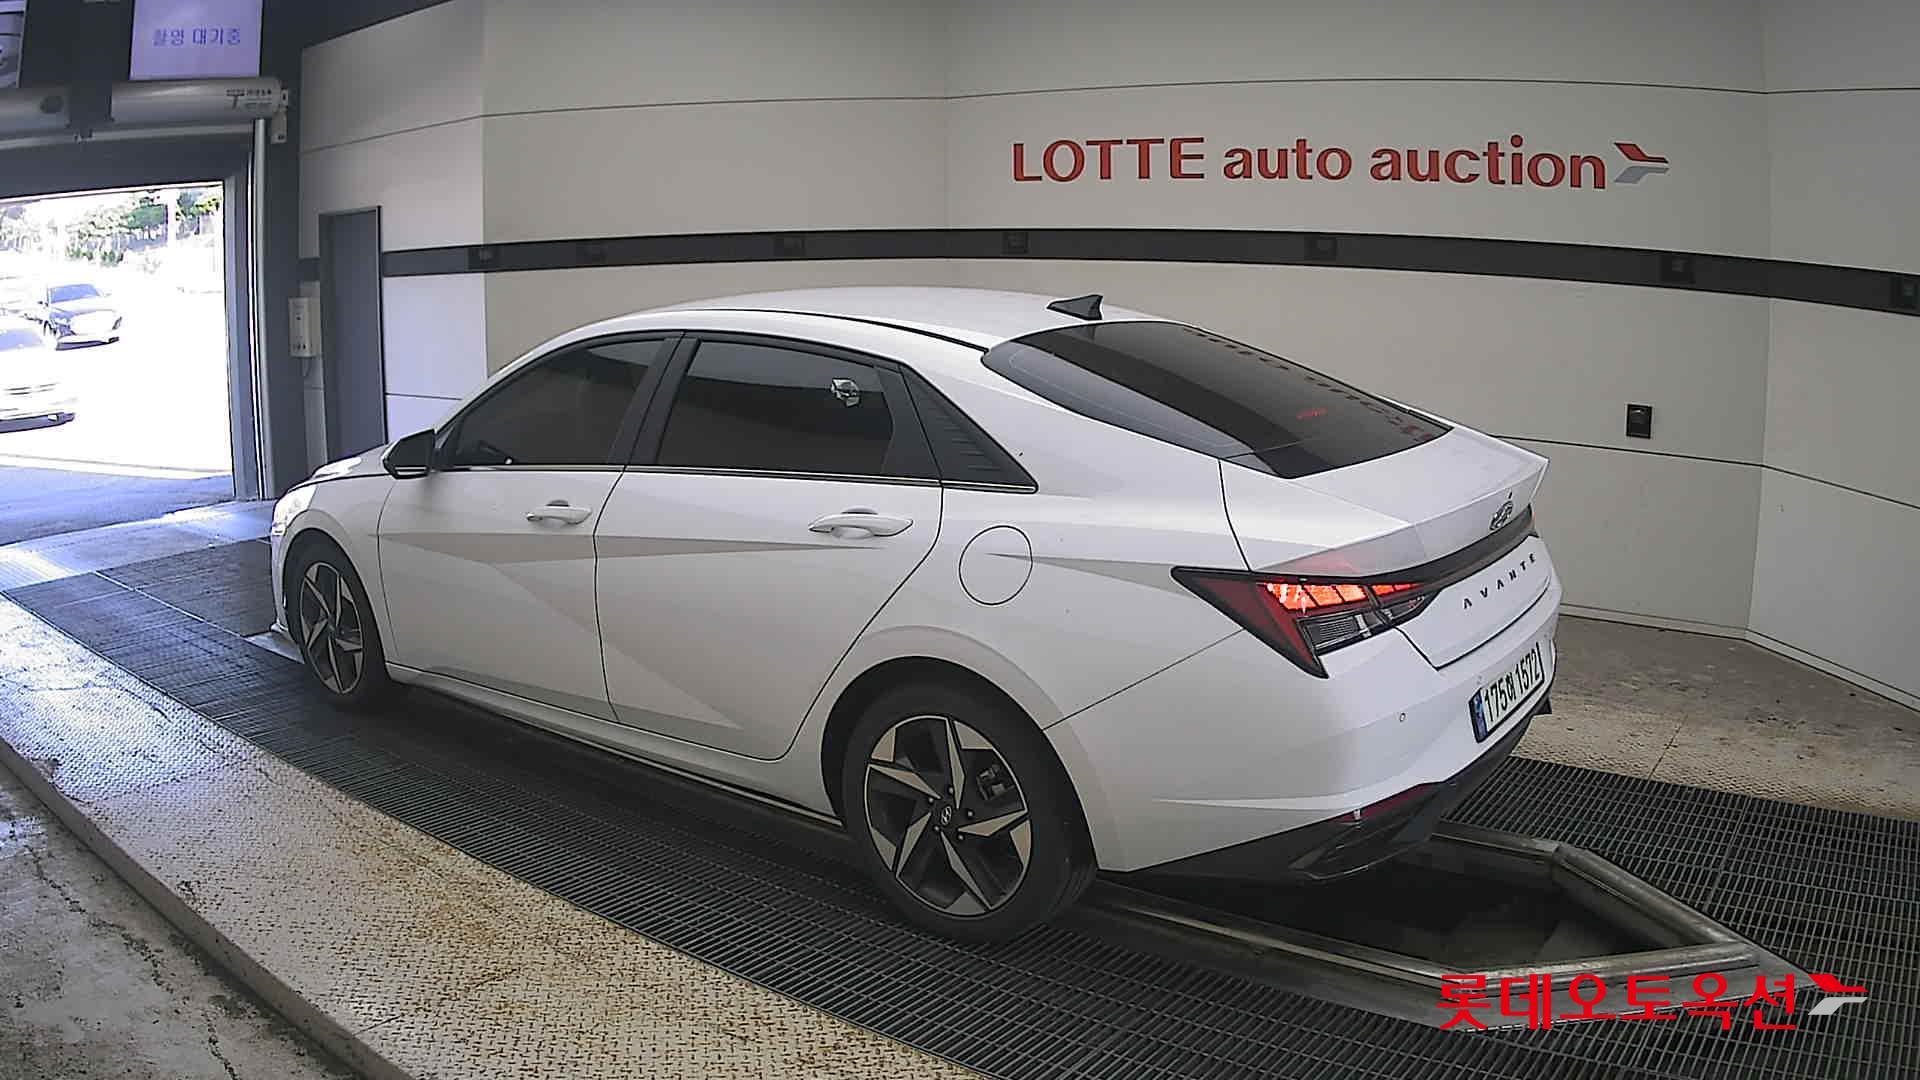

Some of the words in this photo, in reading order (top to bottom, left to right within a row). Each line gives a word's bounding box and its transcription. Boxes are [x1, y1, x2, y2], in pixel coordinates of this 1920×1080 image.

[1012, 137, 1206, 183] LOTTE
[1223, 138, 1354, 181] auto
[1370, 134, 1607, 190] auction
[1463, 553, 1537, 610] AVANTE
[1515, 648, 1541, 695] 1572
